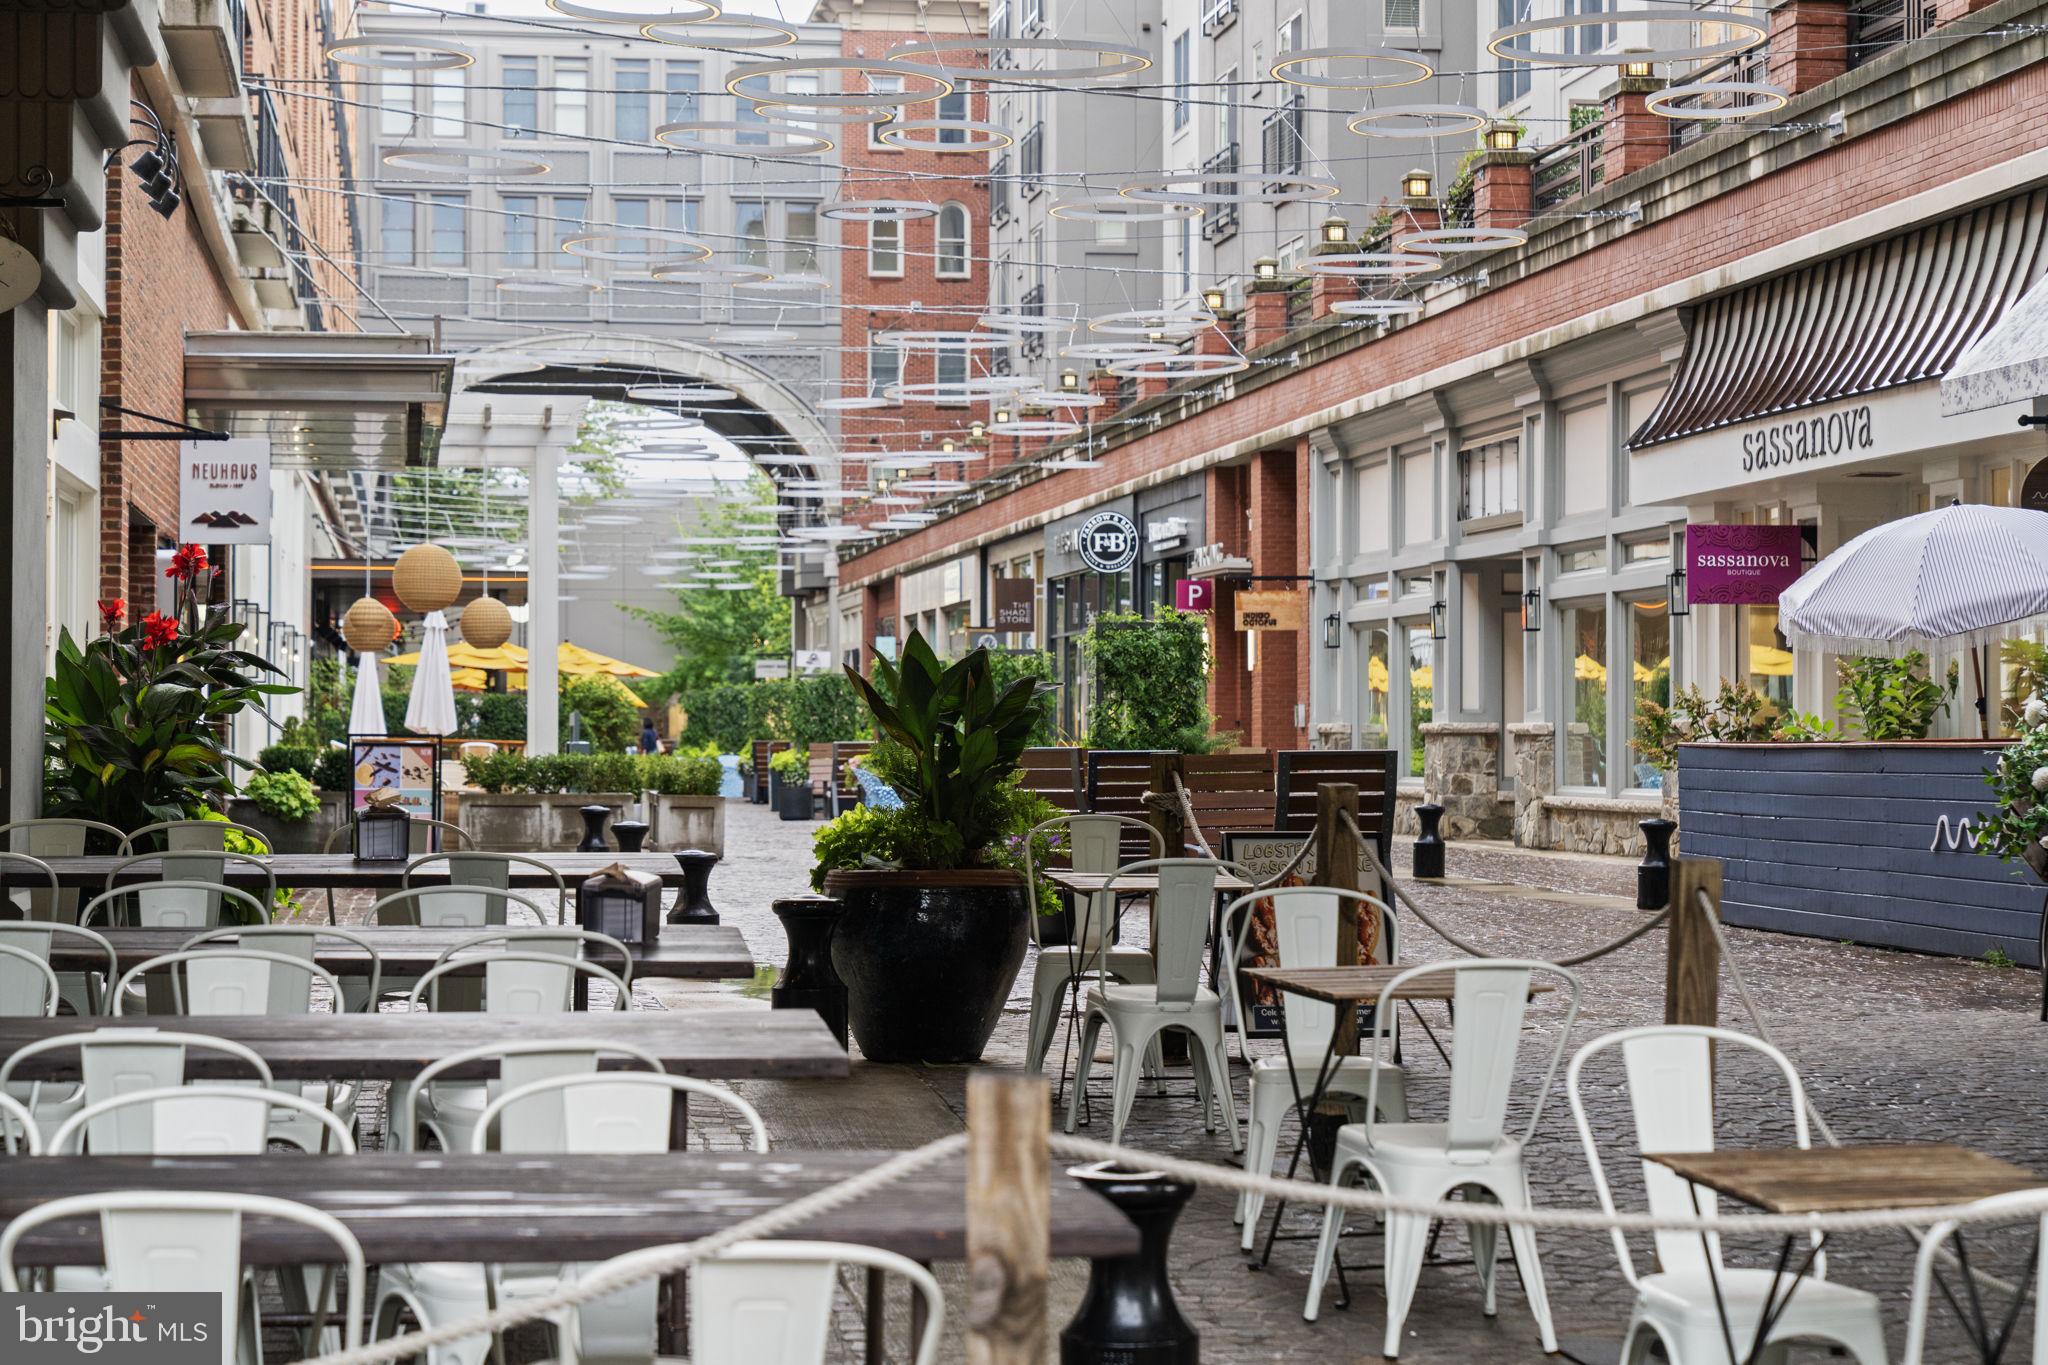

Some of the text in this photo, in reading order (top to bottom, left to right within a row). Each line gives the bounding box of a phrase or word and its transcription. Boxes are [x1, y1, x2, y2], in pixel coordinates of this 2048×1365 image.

[1743, 405, 1873, 472] sassanova
[192, 463, 257, 480] NEUHAUS
[1082, 514, 1110, 538] FARROW
[1120, 519, 1135, 539] BALL
[1093, 532, 1126, 552] F&B
[1697, 554, 1790, 568] sassanova
[1188, 584, 1203, 607] P
[999, 616, 1031, 624] STORE
